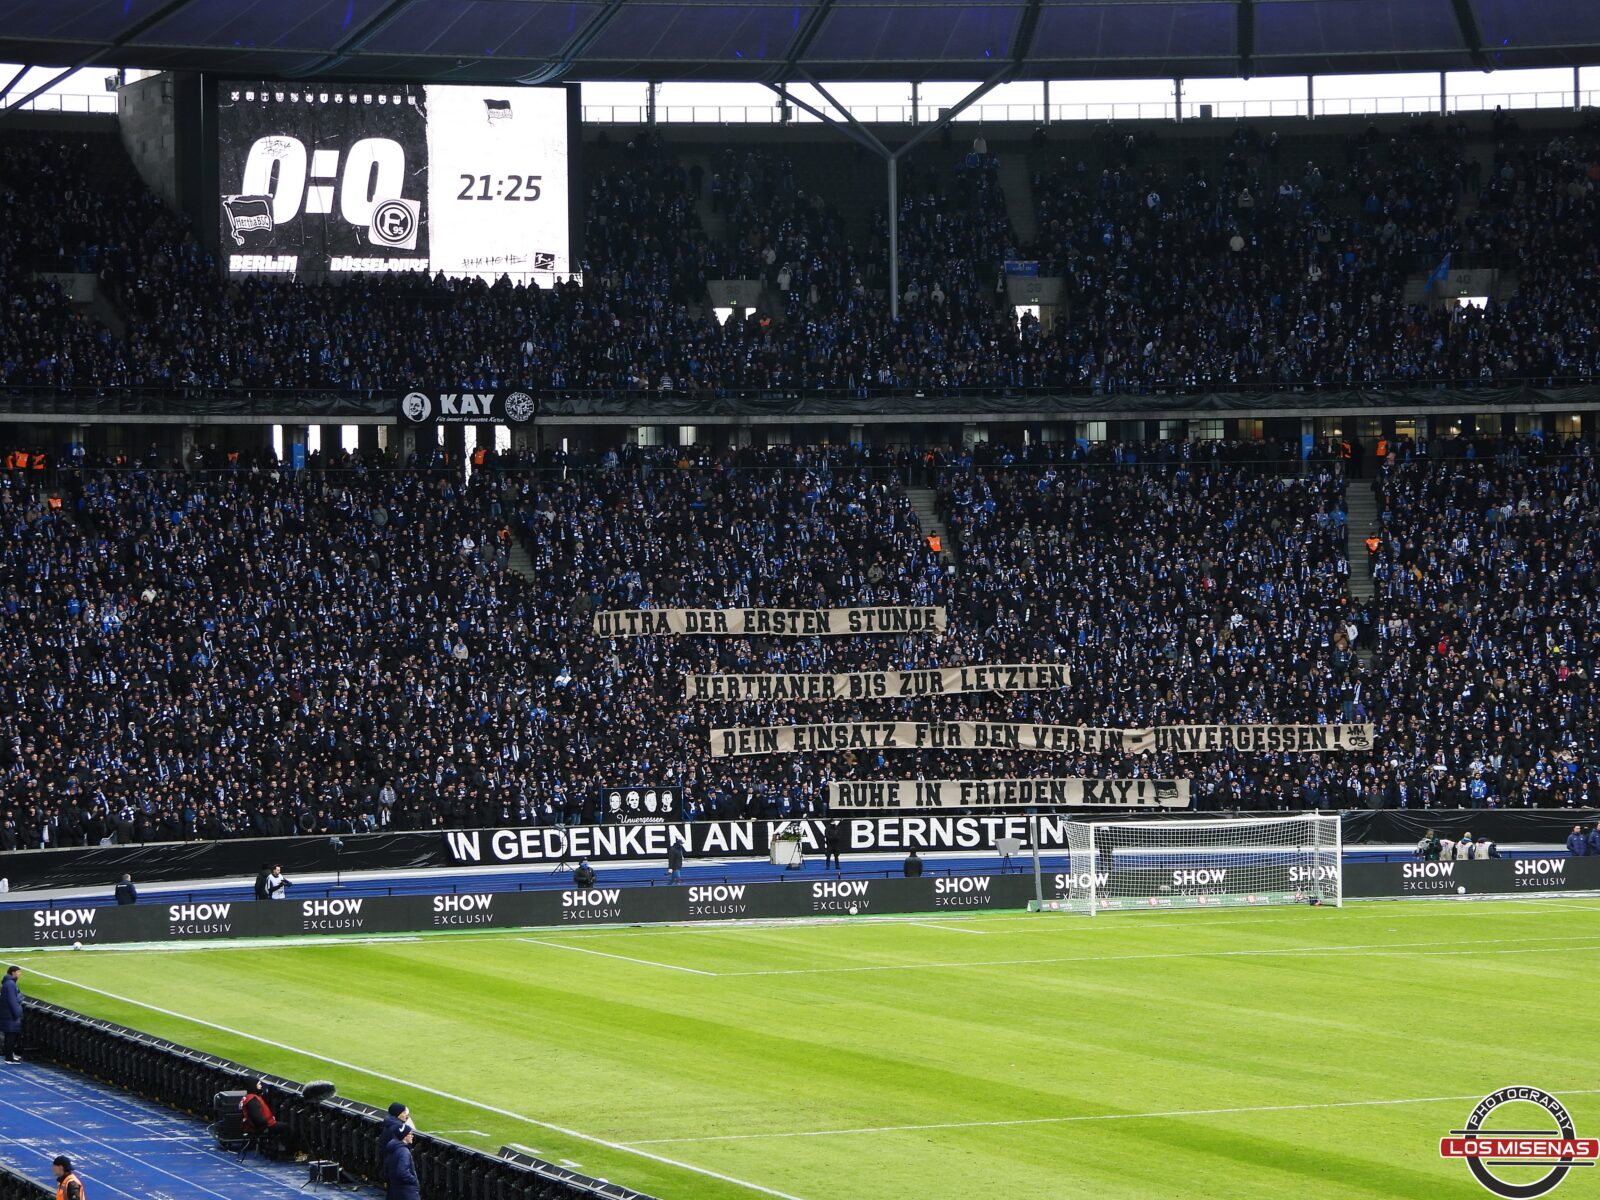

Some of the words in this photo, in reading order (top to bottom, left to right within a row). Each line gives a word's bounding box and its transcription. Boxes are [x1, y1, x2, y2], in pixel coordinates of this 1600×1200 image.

[457, 174, 542, 201] 21:25
[392, 226, 404, 235] 95
[440, 394, 494, 414] KAY
[598, 612, 672, 636] ULTRA
[685, 611, 728, 632] DER
[744, 611, 830, 634] ERSTEN
[848, 608, 936, 632] STUNDE
[694, 676, 836, 699] HERTHANER
[849, 675, 886, 698] BIS
[900, 672, 944, 695] ZUR
[960, 666, 1066, 691] LETZTEN
[723, 728, 778, 754] DEIN
[794, 724, 896, 750] EINSATZ
[915, 722, 962, 748] FÜR
[974, 724, 1020, 750] DEN
[1032, 726, 1124, 753] VEREIN
[1349, 736, 1370, 746] 03
[838, 783, 900, 806] RUHE
[916, 782, 942, 806] IN
[960, 780, 1066, 805] FRIEDEN
[1082, 780, 1145, 804] KAY!
[616, 814, 665, 824] Unvergessen
[447, 830, 480, 861] IN
[492, 821, 692, 861] GEDENKEN
[702, 820, 754, 852] AN
[1290, 866, 1338, 882] SHOW
[1403, 862, 1454, 878] SHOW
[1514, 858, 1566, 875] SHOW
[935, 876, 990, 894] SHOW
[1055, 872, 1109, 890] SHOW
[1174, 869, 1226, 886] SHOW
[1404, 880, 1455, 890] EXCLUSIV
[1516, 878, 1566, 886] EXCLUSIV
[688, 885, 746, 902] SHOW
[812, 881, 868, 898] SHOW
[433, 894, 493, 912] SHOW
[562, 889, 620, 908] SHOW
[936, 896, 991, 906] EXCLUSIV
[169, 904, 231, 922] SHOW
[303, 898, 363, 917] SHOW
[563, 908, 622, 920] EXCLUSIV
[689, 904, 746, 915] EXCLUSIV
[34, 908, 96, 927] SHOW
[304, 919, 364, 930] EXCLUSIV
[434, 914, 494, 925] EXCLUSIV
[34, 929, 97, 941] EXCLUSIV
[170, 924, 232, 935] EXCLUSIV
